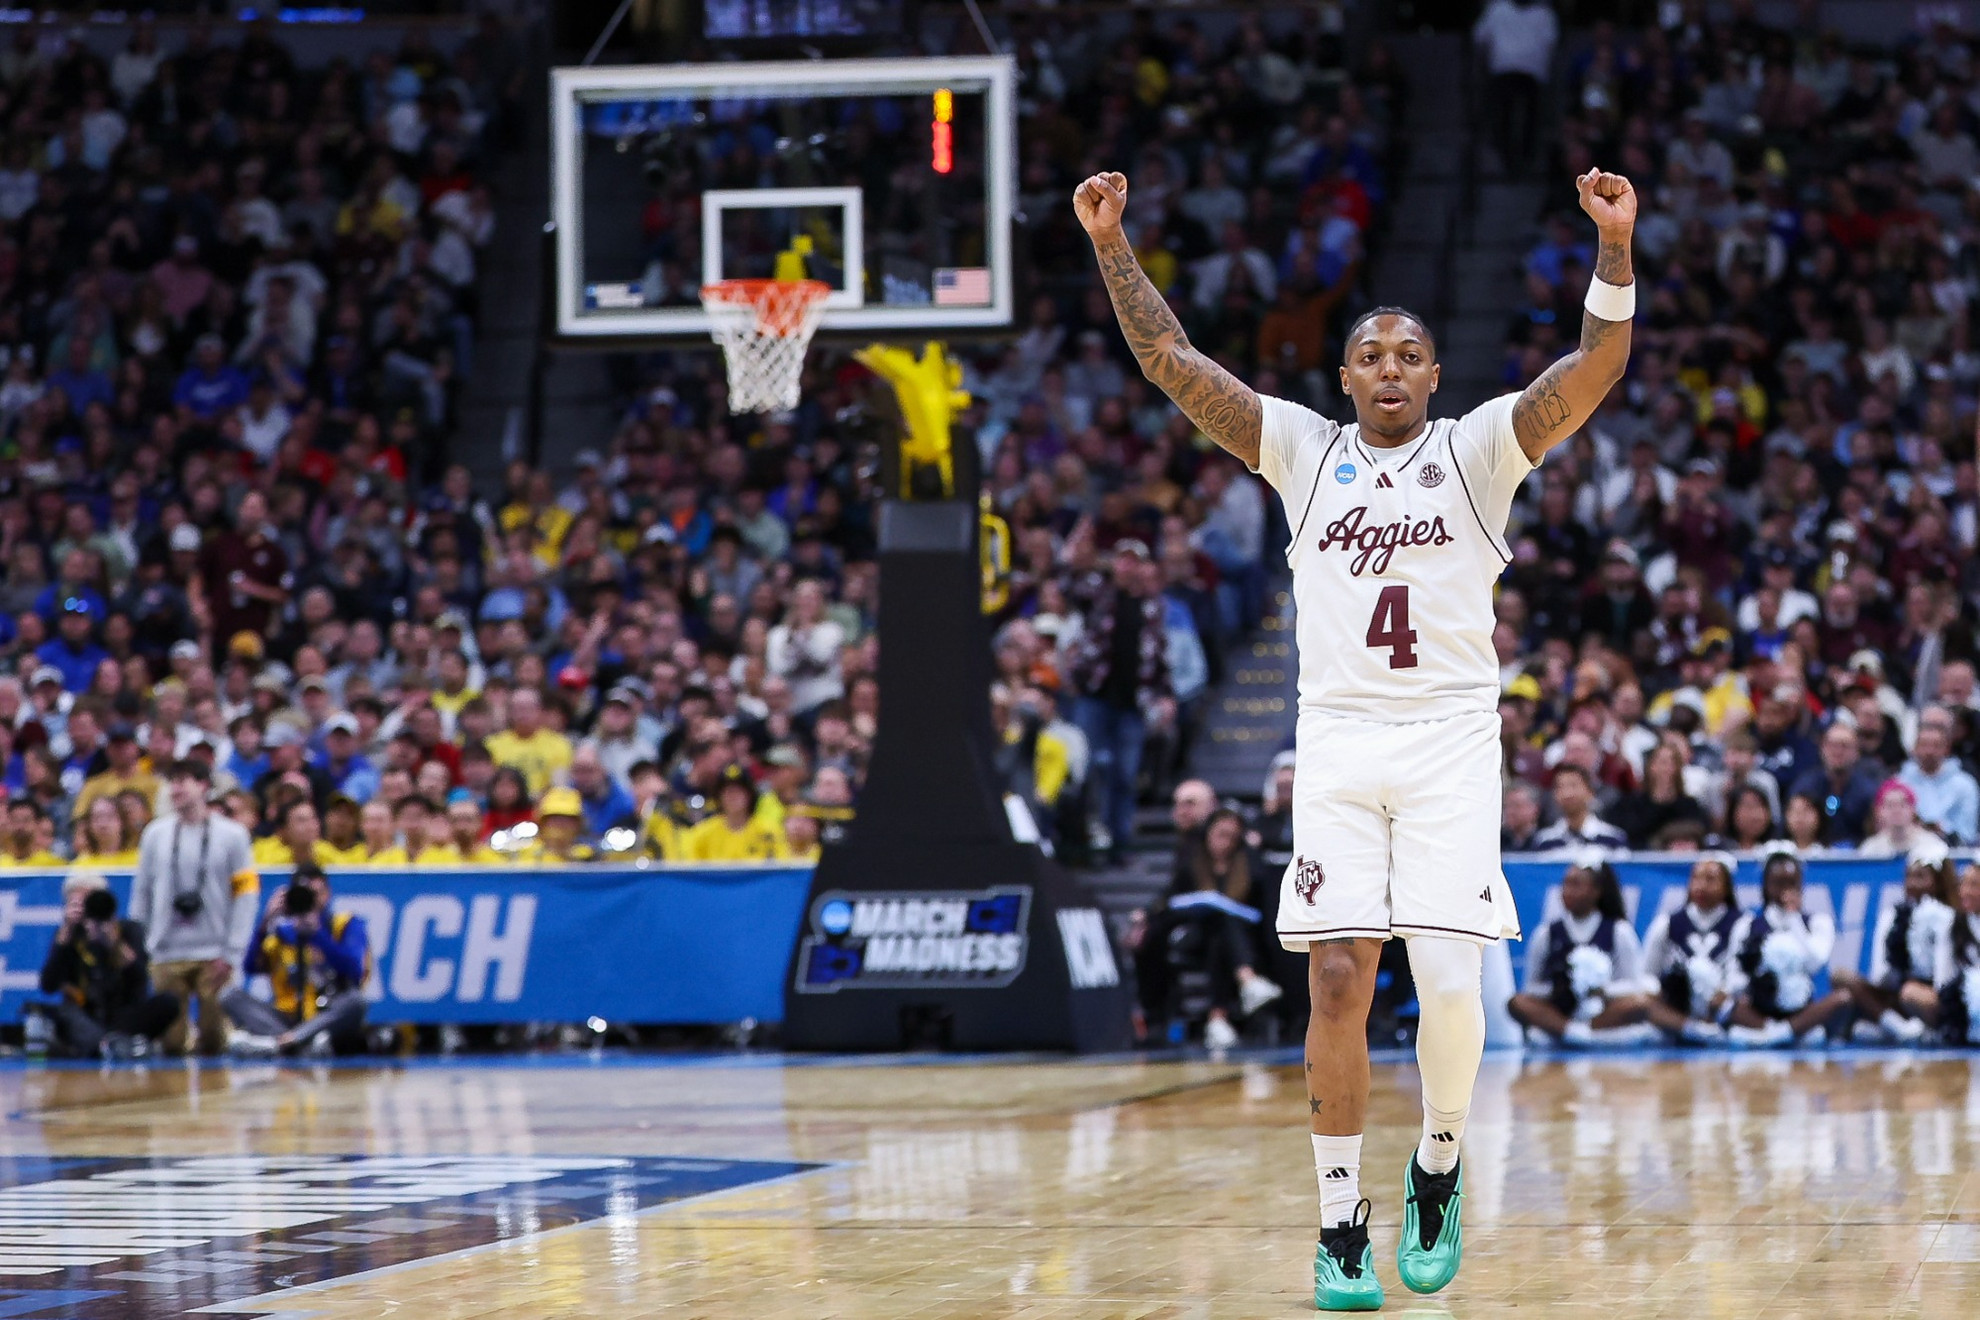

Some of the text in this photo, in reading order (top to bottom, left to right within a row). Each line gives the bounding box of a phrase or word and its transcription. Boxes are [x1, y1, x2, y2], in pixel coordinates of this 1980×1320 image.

[1422, 464, 1439, 481] SEC
[1318, 506, 1454, 577] Aggies
[1366, 585, 1418, 669] 4
[851, 898, 969, 936] MARCH
[330, 893, 538, 1003] RCH
[863, 932, 1022, 972] MADNESS
